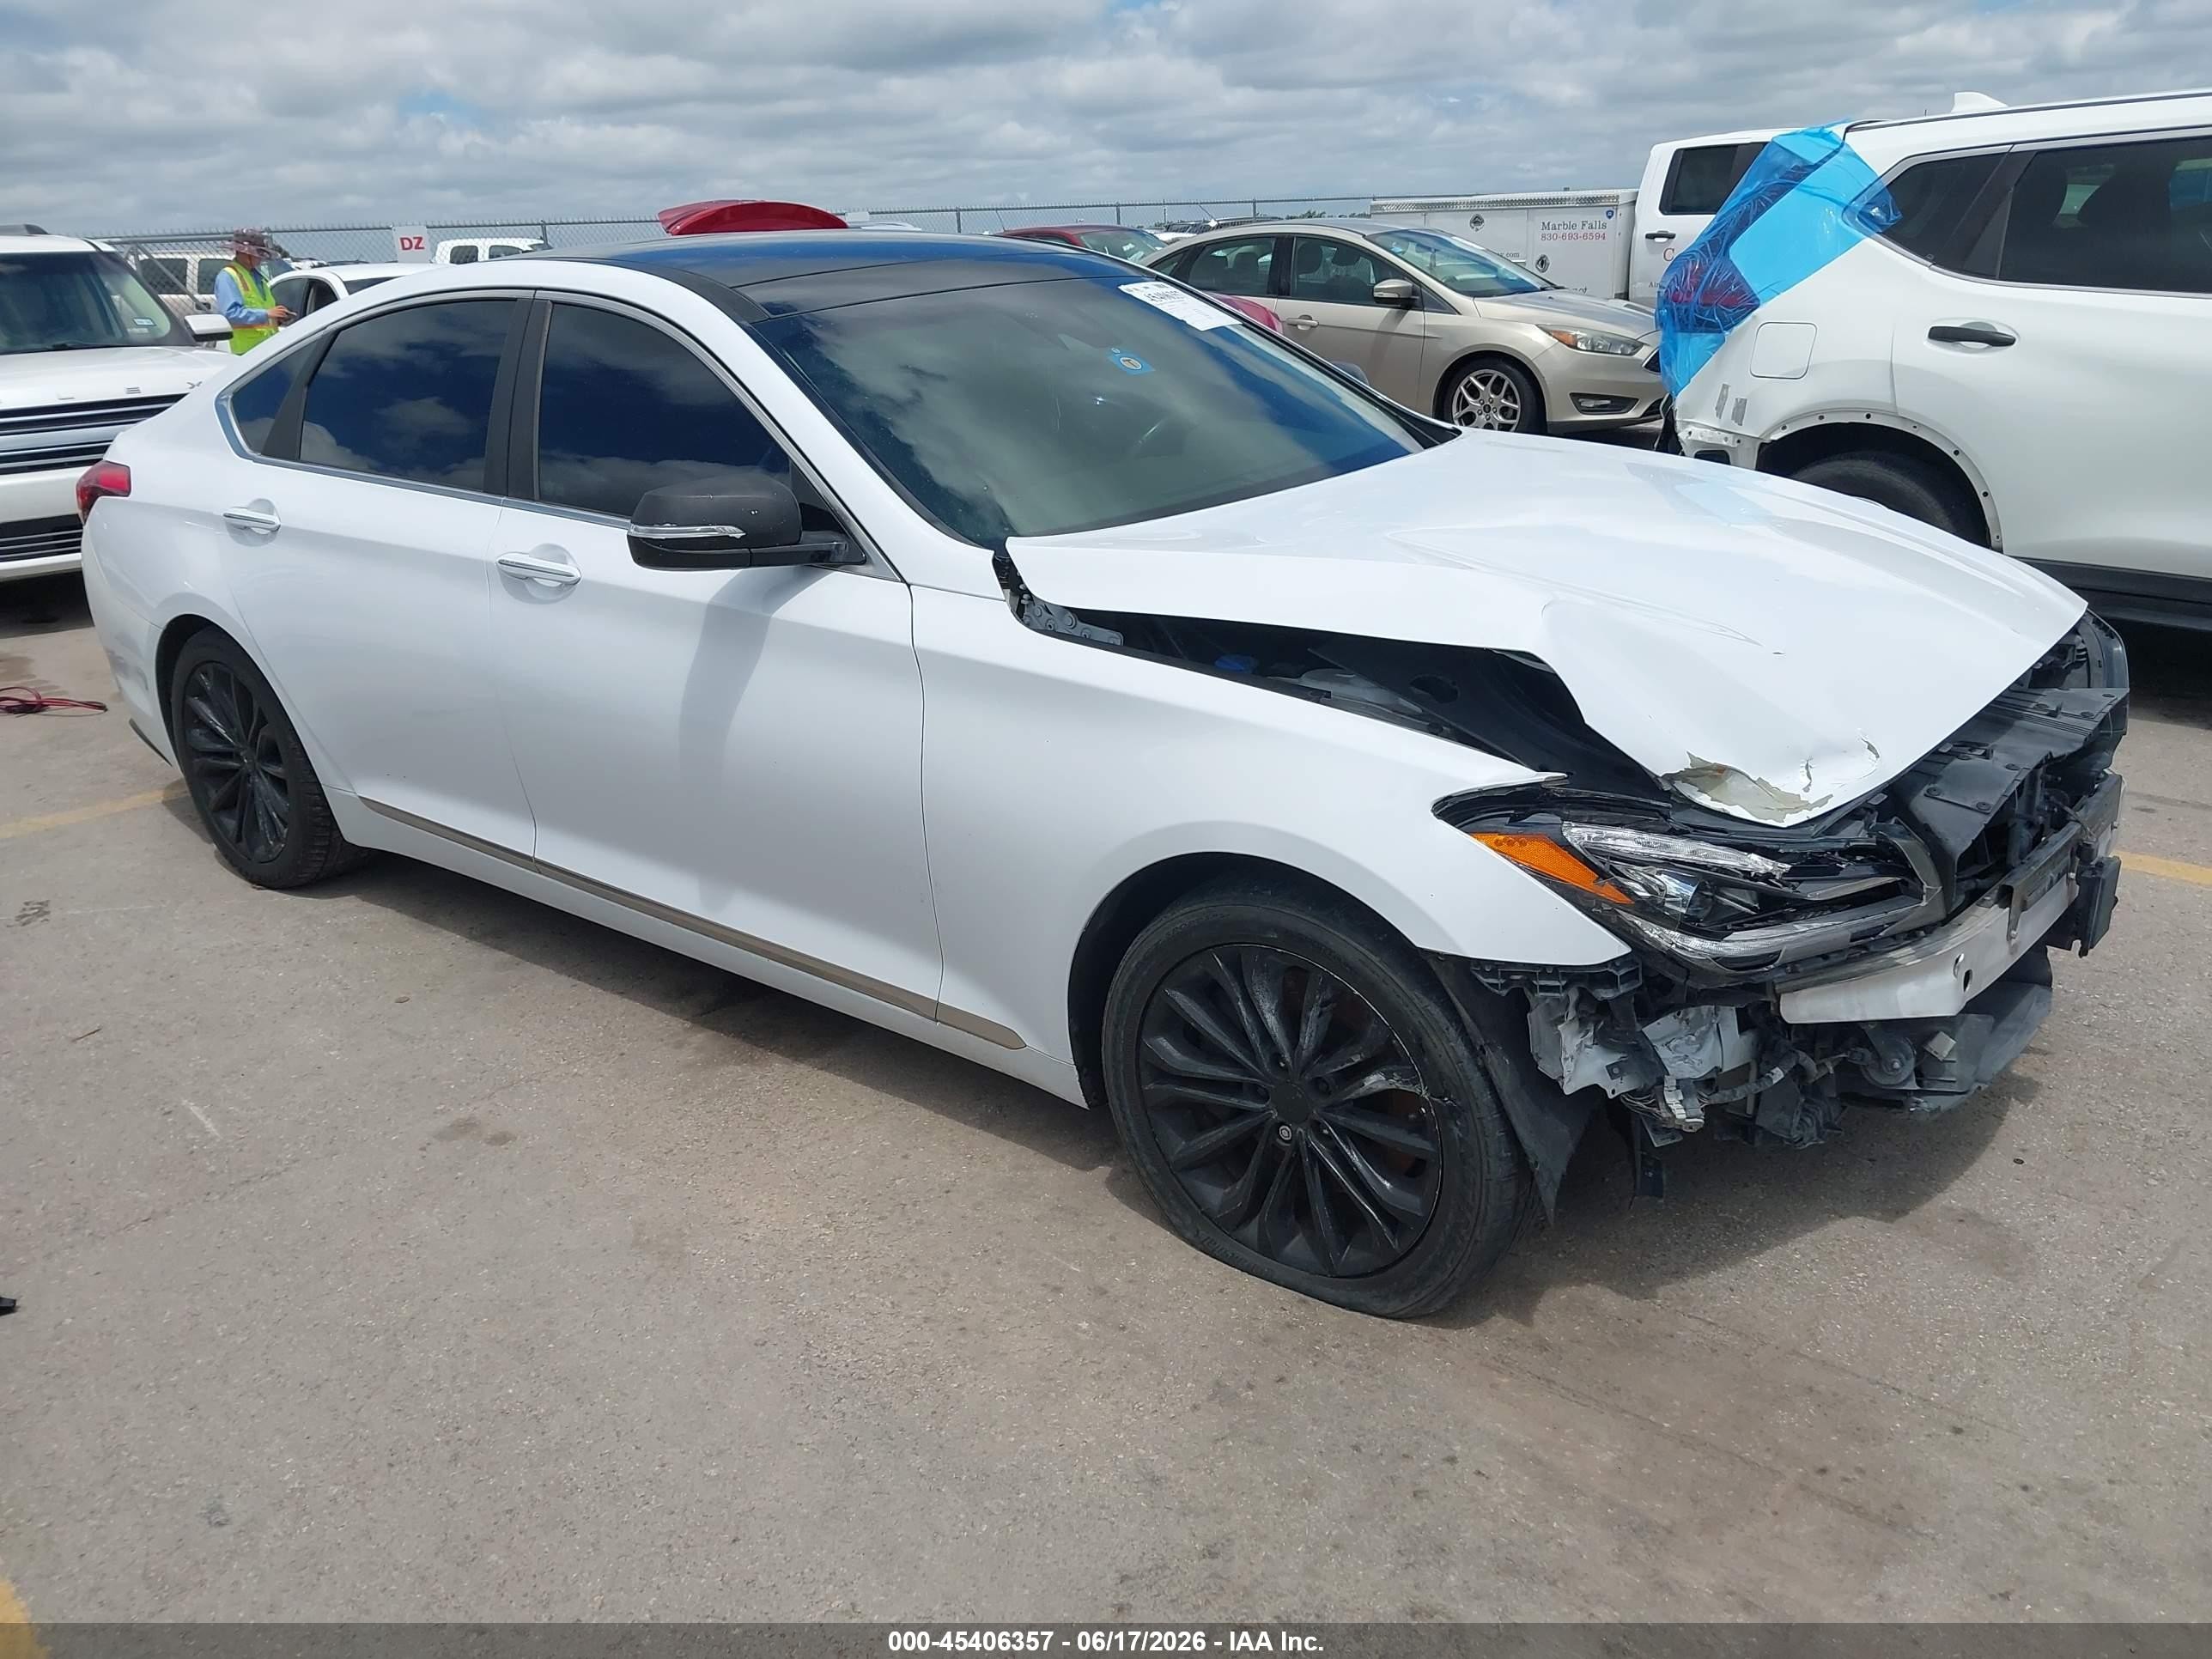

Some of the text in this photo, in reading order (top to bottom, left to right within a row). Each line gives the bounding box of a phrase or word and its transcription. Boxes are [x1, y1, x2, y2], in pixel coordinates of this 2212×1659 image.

[1540, 220, 1607, 231] Marble Falls
[1540, 232, 1607, 241] 830-693-6594
[399, 236, 426, 251] DZ
